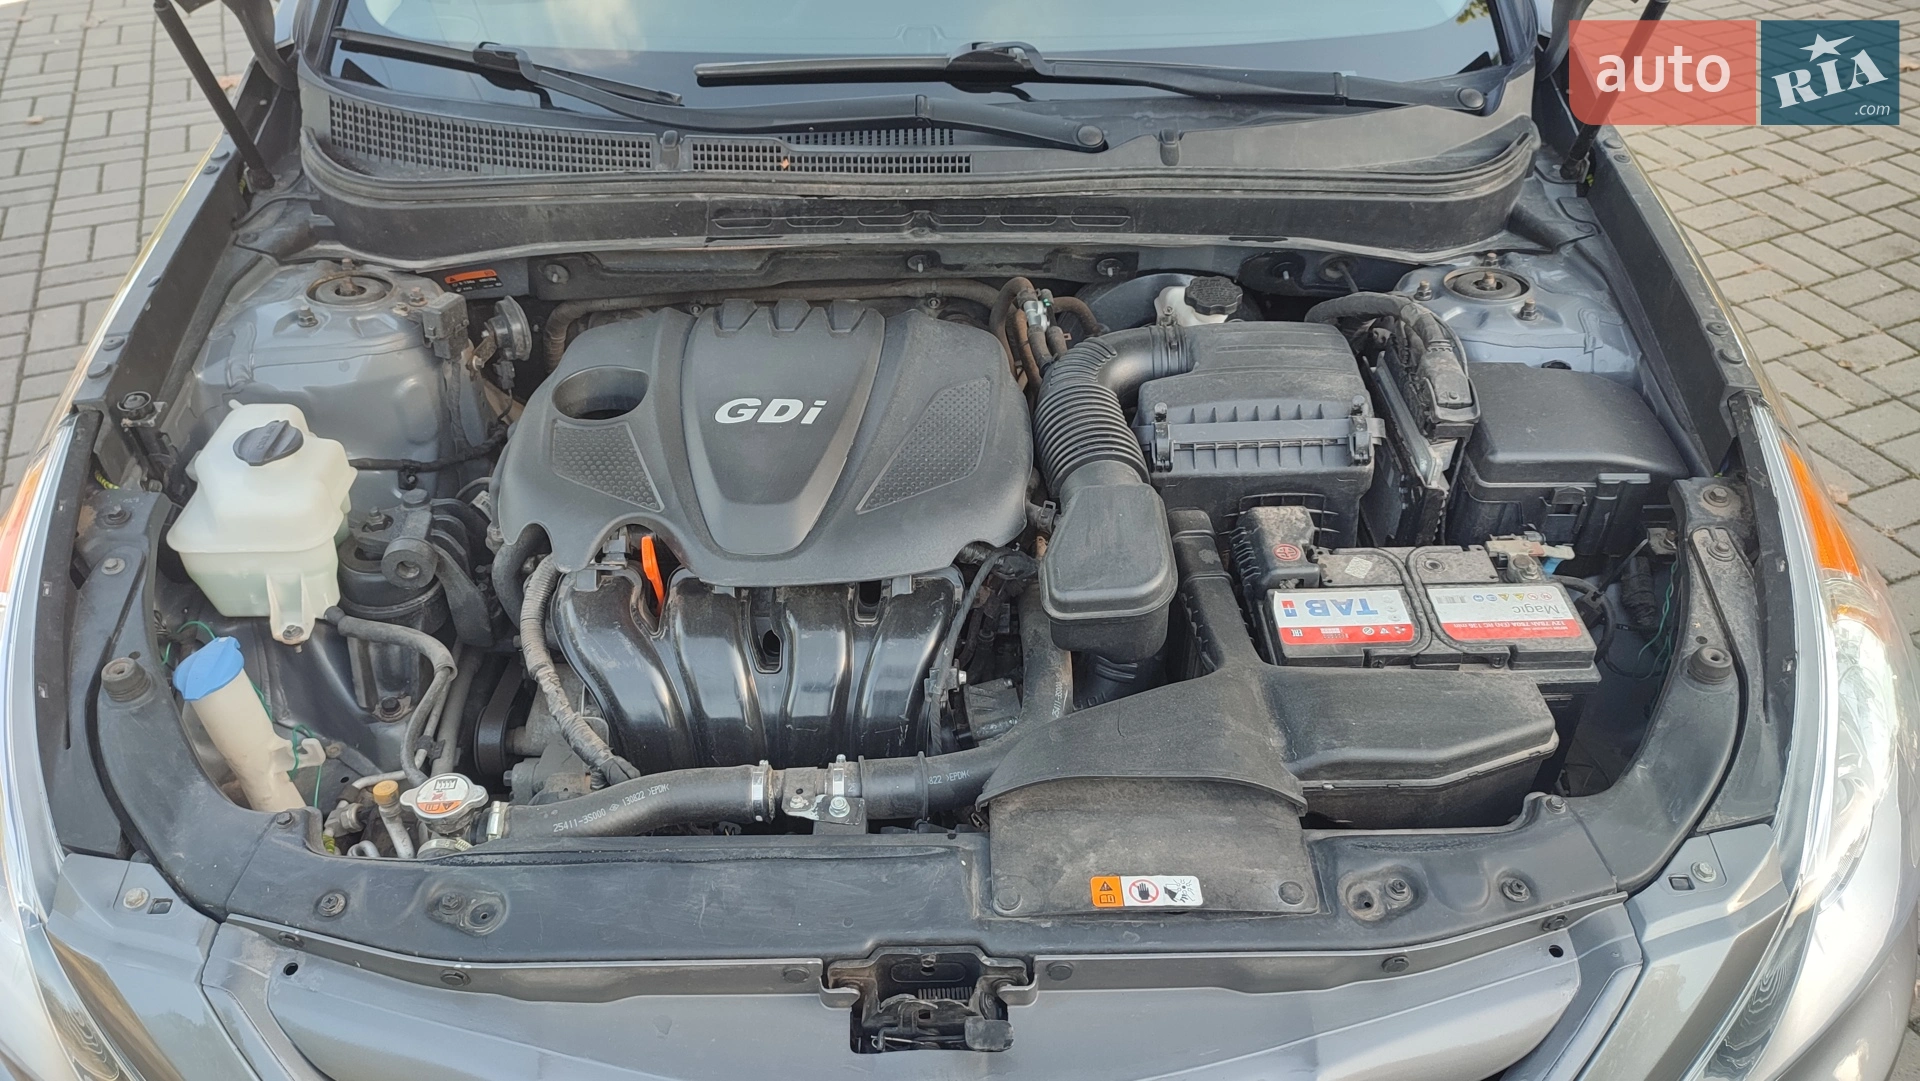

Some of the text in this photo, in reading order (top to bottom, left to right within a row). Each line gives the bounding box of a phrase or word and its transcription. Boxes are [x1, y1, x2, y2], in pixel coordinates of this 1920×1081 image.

[714, 397, 828, 425] GDi
[1305, 598, 1379, 617] TAB
[1512, 604, 1560, 615] Magic
[928, 774, 943, 785] 822
[553, 808, 607, 833] 25411-3S000
[622, 790, 646, 807] 130822
